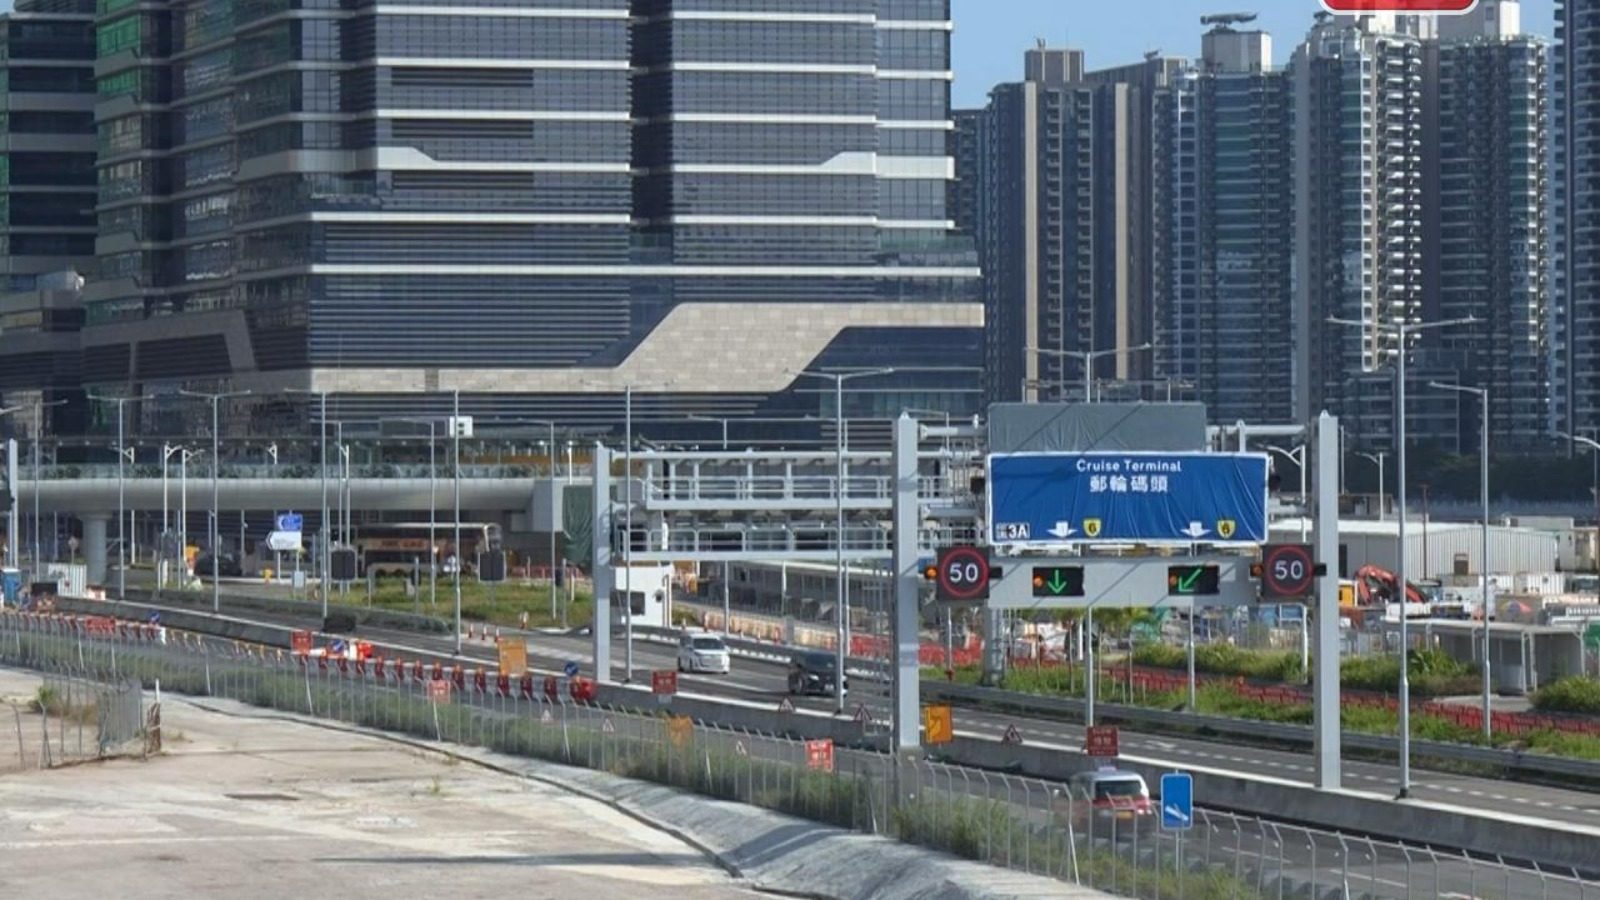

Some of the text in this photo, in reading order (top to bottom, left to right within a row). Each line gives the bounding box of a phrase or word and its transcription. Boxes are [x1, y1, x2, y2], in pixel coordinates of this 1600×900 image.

[1076, 458, 1182, 472] Cruise Terminal
[1089, 474, 1169, 493] 郵輪碼頭
[1008, 523, 1028, 538] 3A
[950, 562, 979, 583] 50
[1275, 560, 1304, 580] 50
